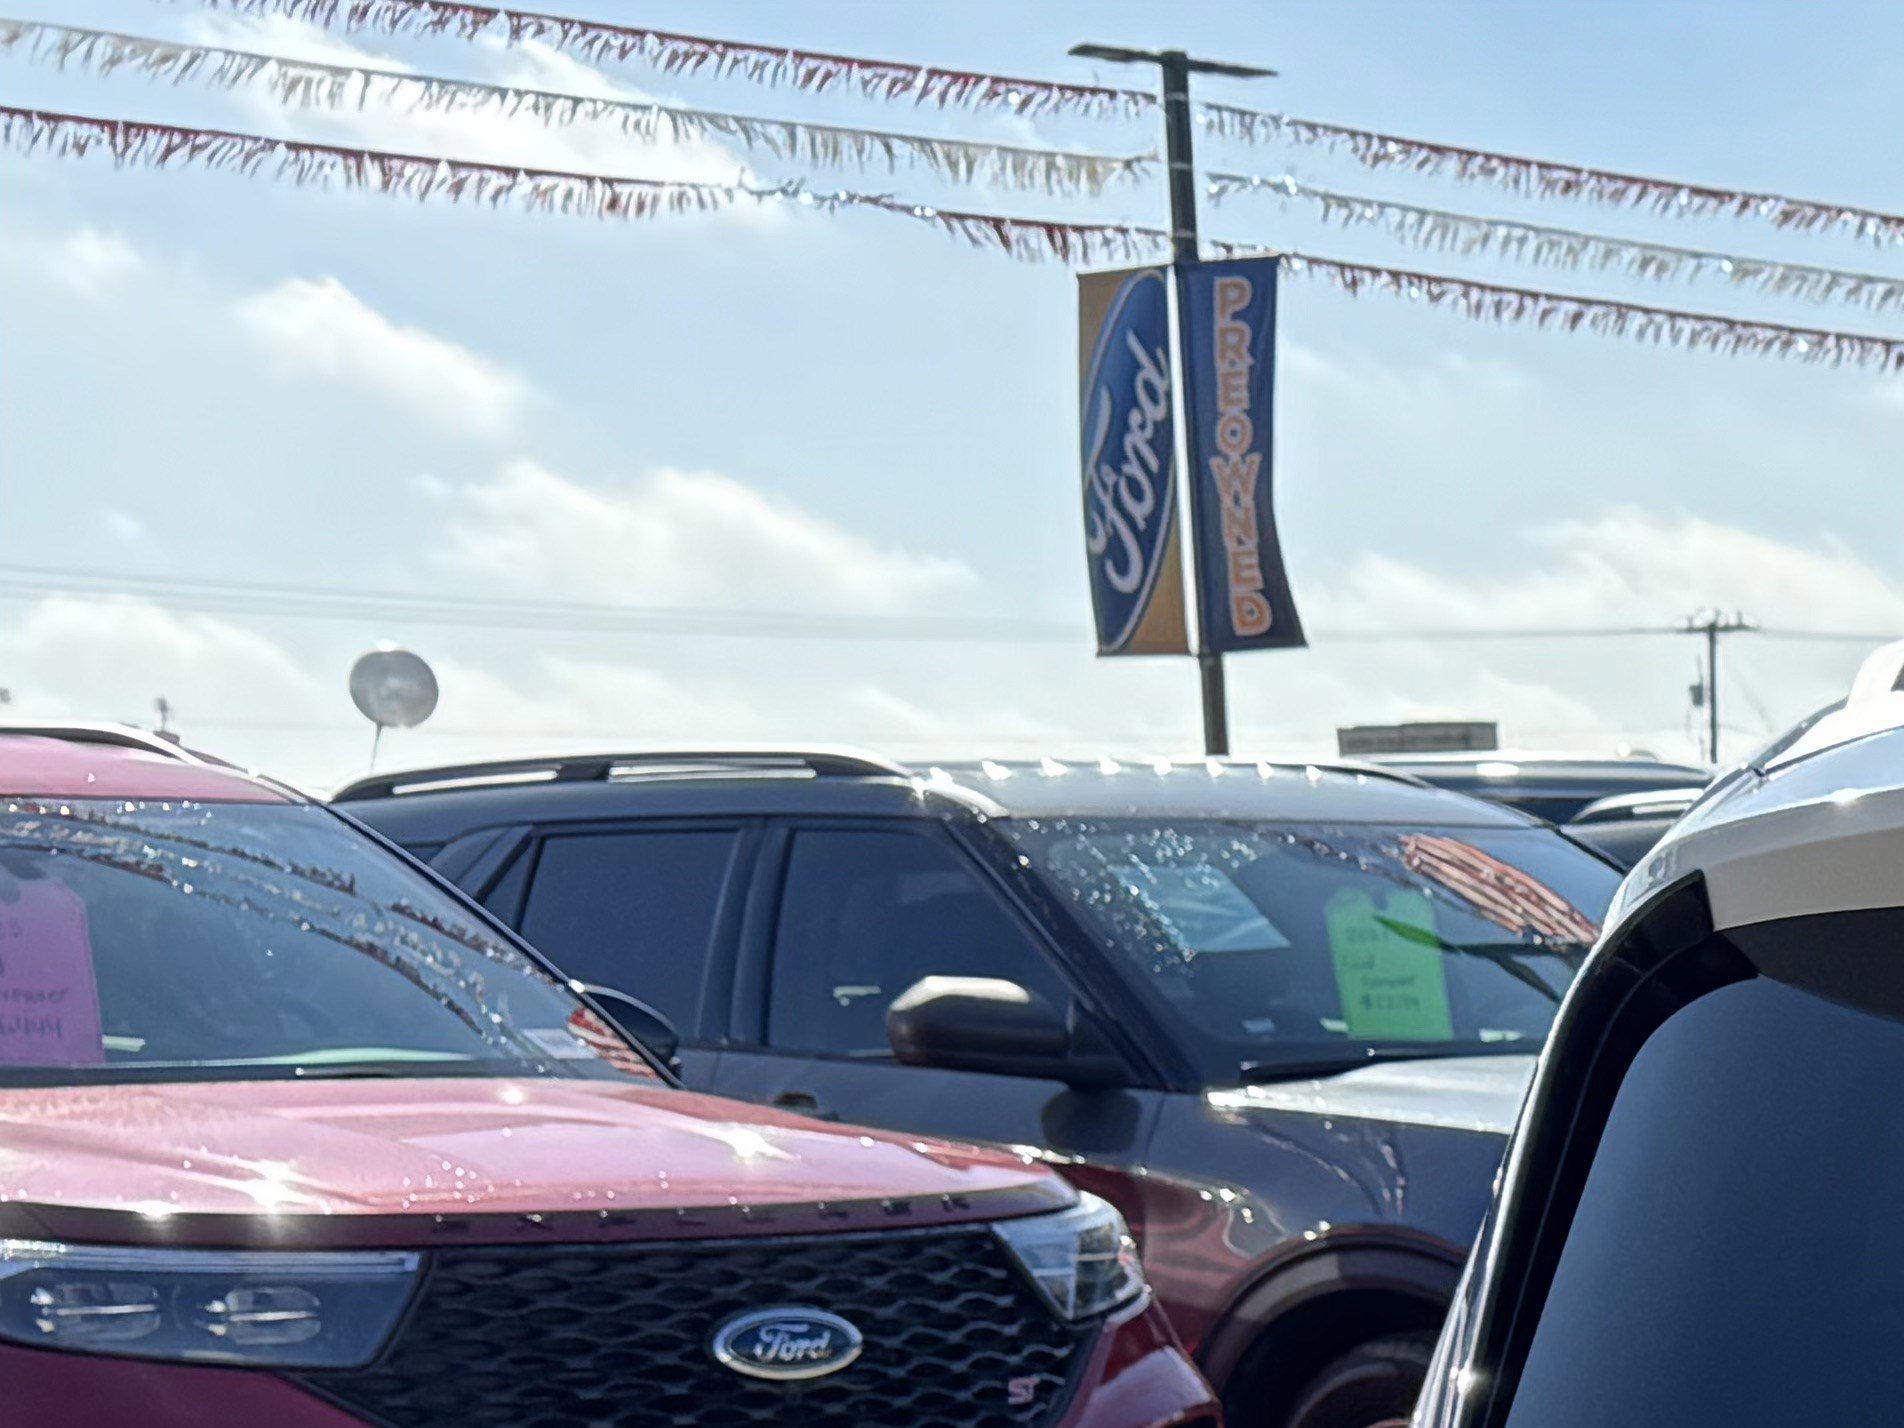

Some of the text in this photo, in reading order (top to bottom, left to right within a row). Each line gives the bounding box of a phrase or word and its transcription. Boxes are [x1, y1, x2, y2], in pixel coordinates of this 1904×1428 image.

[1087, 329, 1172, 594] Ford
[753, 1323, 832, 1362] Ford
[1007, 1376, 1040, 1404] ST
